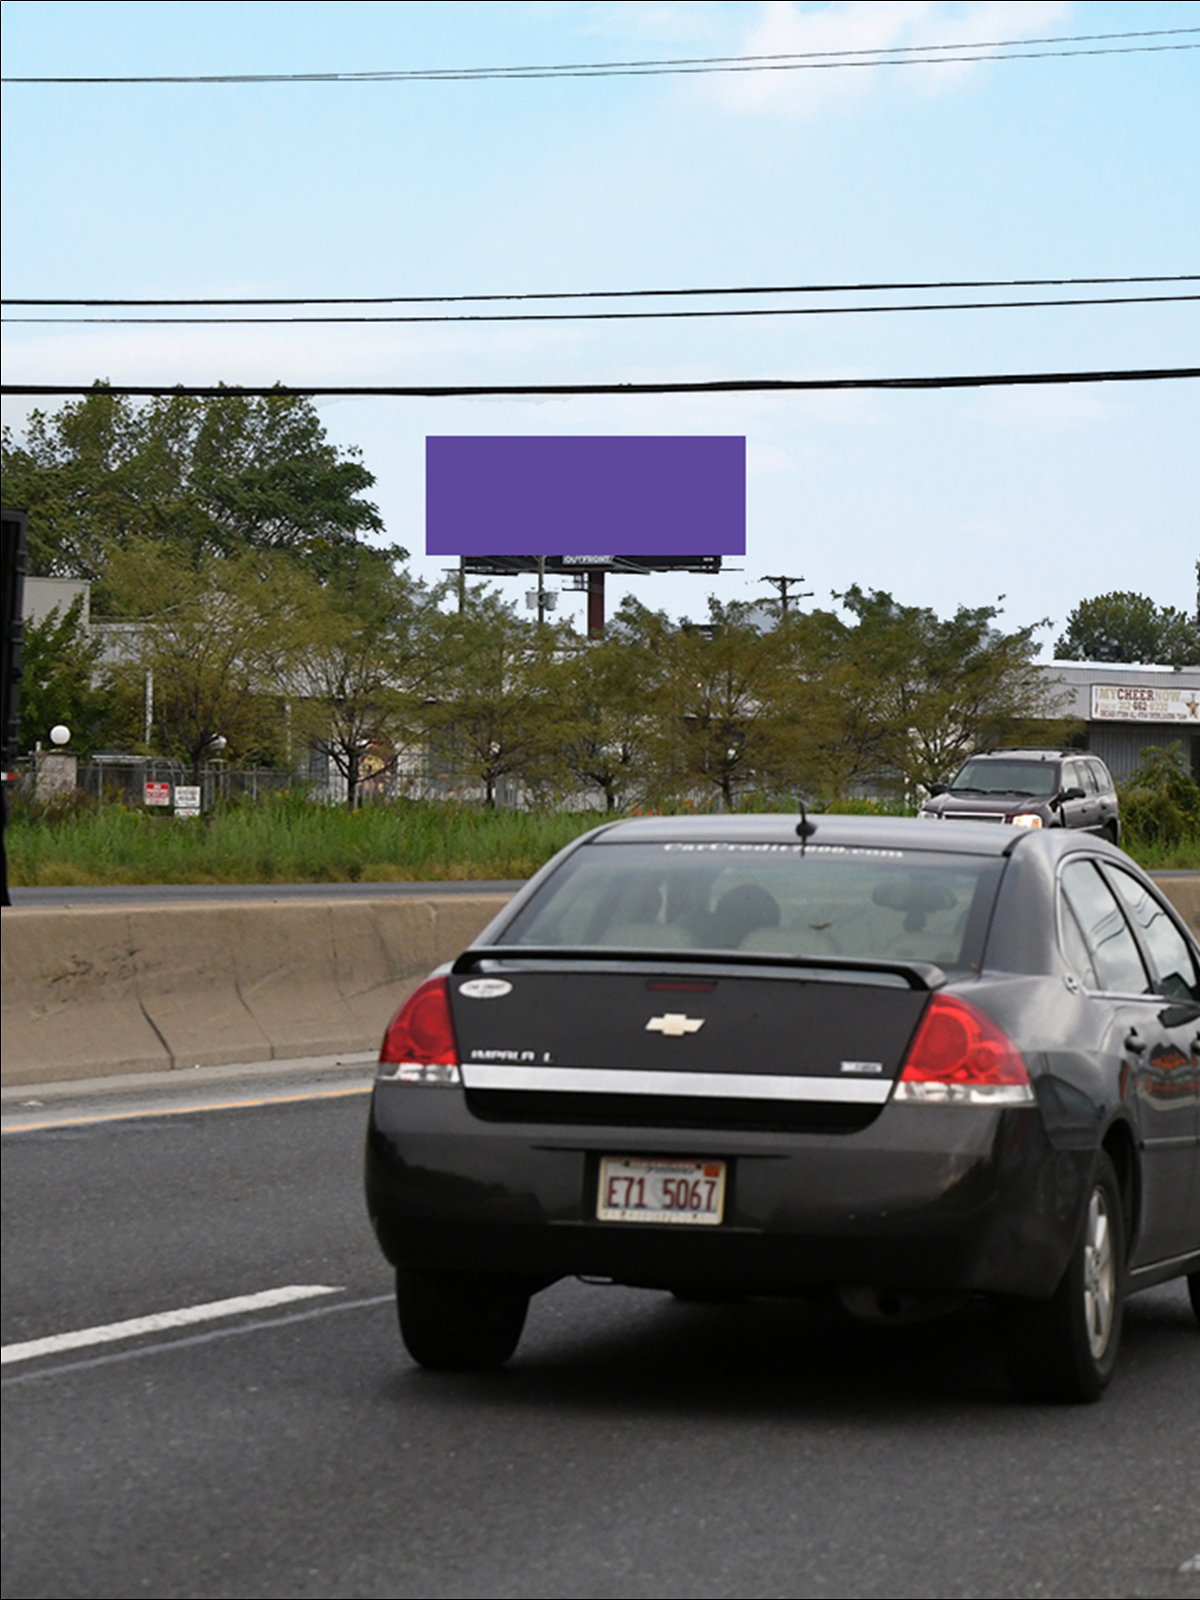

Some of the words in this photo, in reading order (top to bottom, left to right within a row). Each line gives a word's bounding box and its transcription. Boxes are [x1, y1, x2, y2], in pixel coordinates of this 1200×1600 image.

[471, 1049, 536, 1061] IMPALA
[607, 1176, 646, 1208] E71
[663, 1178, 717, 1211] 5067
